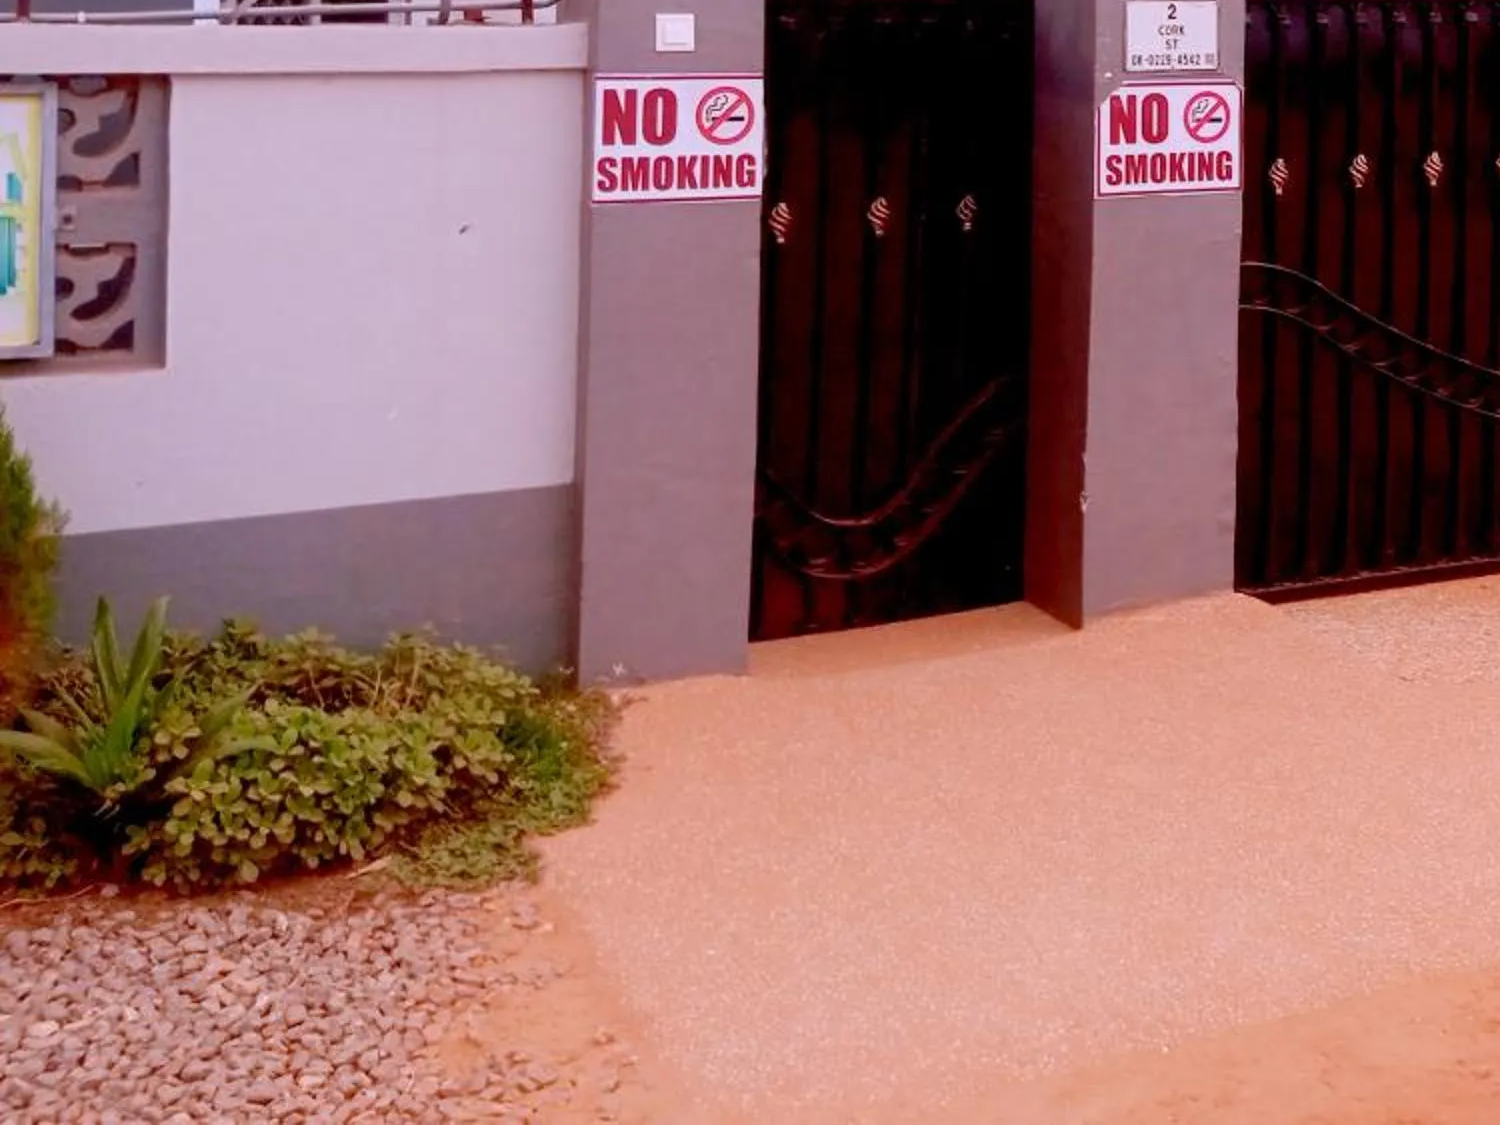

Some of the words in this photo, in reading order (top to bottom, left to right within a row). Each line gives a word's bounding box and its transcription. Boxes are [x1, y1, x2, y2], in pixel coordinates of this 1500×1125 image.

[1167, 2, 1177, 20] 2
[1165, 38, 1180, 50] ST
[601, 87, 678, 146] NO
[1109, 92, 1169, 145] NO
[597, 153, 756, 193] SMOKING
[1105, 150, 1233, 186] SMOKING
